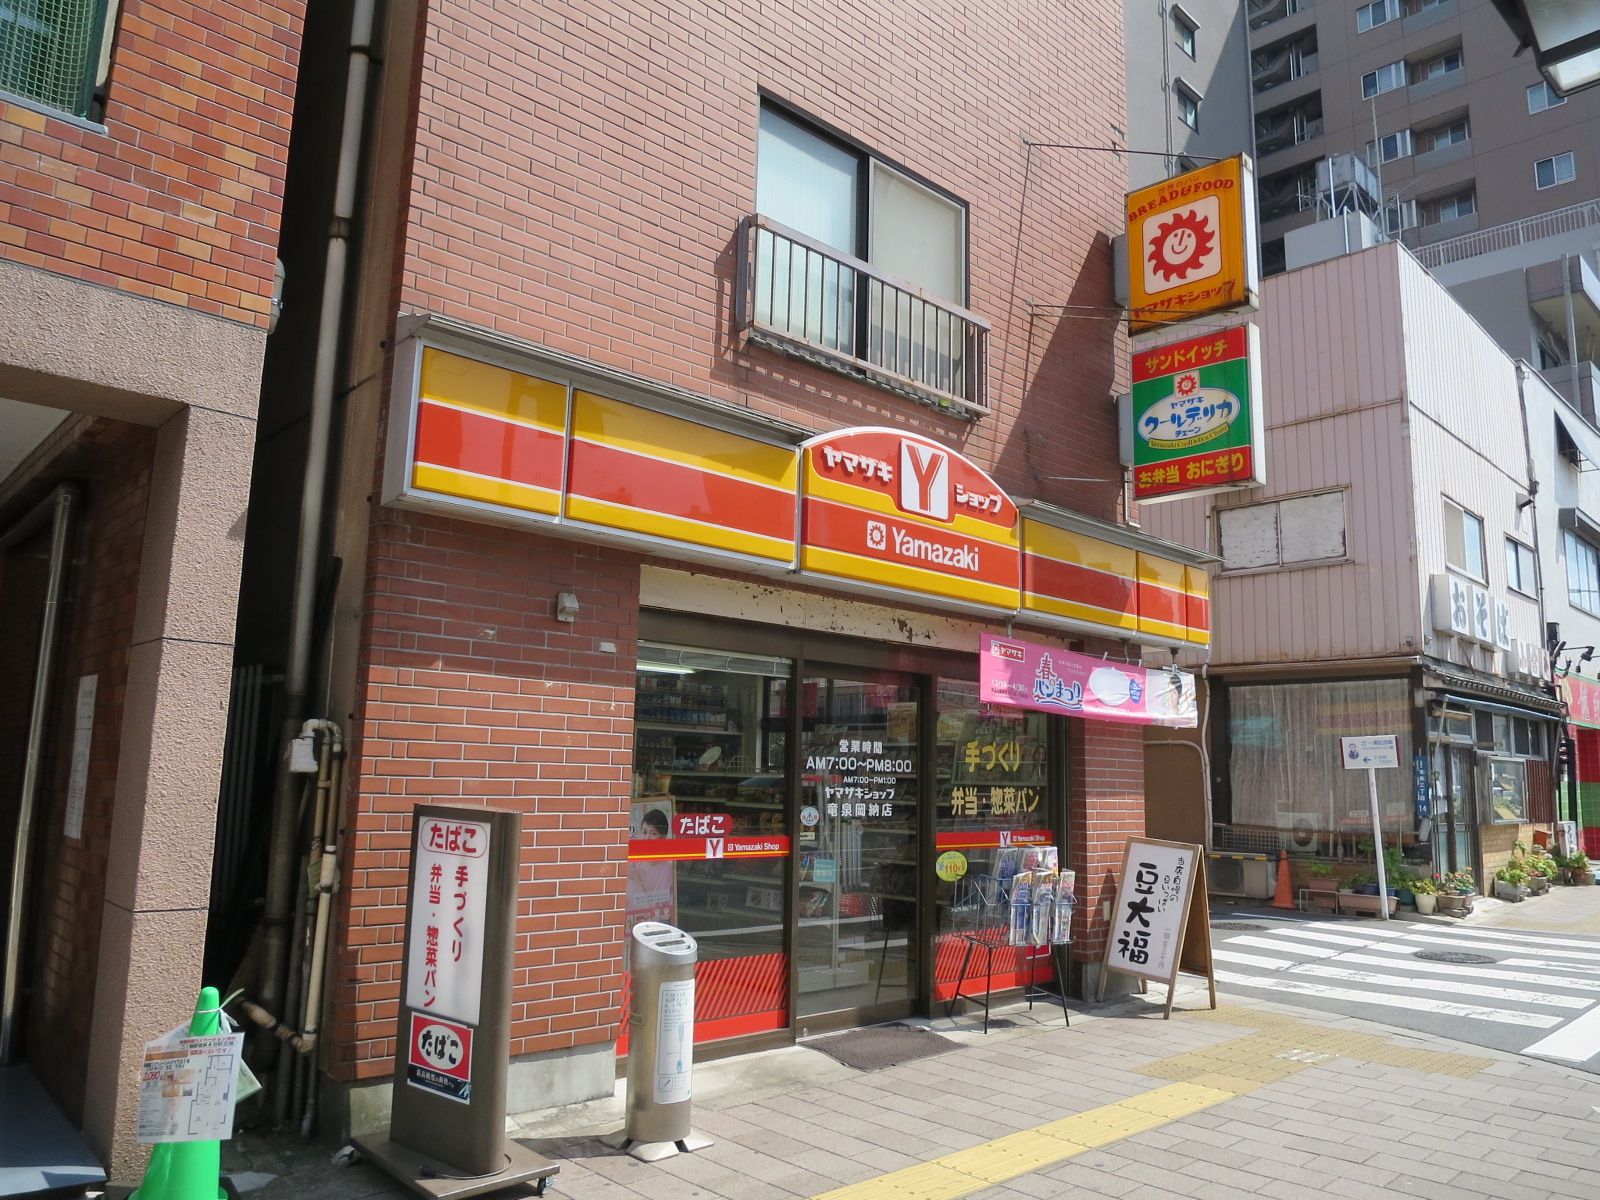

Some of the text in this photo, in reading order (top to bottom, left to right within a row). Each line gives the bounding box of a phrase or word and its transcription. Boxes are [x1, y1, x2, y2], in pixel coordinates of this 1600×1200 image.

[1128, 178, 1235, 223] BREAD&FOOD
[1145, 339, 1228, 374] サンドイッチ
[1144, 400, 1233, 435] クールデリカ
[1170, 396, 1204, 410] ヤマザキ
[1175, 426, 1201, 438] チェーン
[821, 445, 894, 483] ヤマザキ
[906, 443, 944, 514] Y
[1138, 452, 1244, 488] お弁当 おにぎり
[954, 483, 1003, 514] ショップ
[892, 526, 979, 572] Yamazaki
[1000, 645, 1025, 661] ヤマザキ
[1036, 653, 1056, 680] 春
[1035, 679, 1082, 702] パンまつり
[839, 739, 883, 754] 営業時間
[964, 740, 1020, 773] 手づくり
[824, 786, 895, 799] ヤマザキショップ
[951, 786, 1040, 816] 弁当・惣菜パン
[827, 803, 893, 817] 竜泉岡納店
[1419, 804, 1427, 813] 14
[429, 823, 477, 853] たばこ
[679, 815, 725, 835] たばこ
[708, 838, 780, 857] Y Yamazaki Shop
[452, 865, 469, 962] 手づくり
[1117, 862, 1159, 965] 豆大福
[424, 863, 443, 1008] 弁当・惣菜パン
[421, 1029, 459, 1065] たばこ
